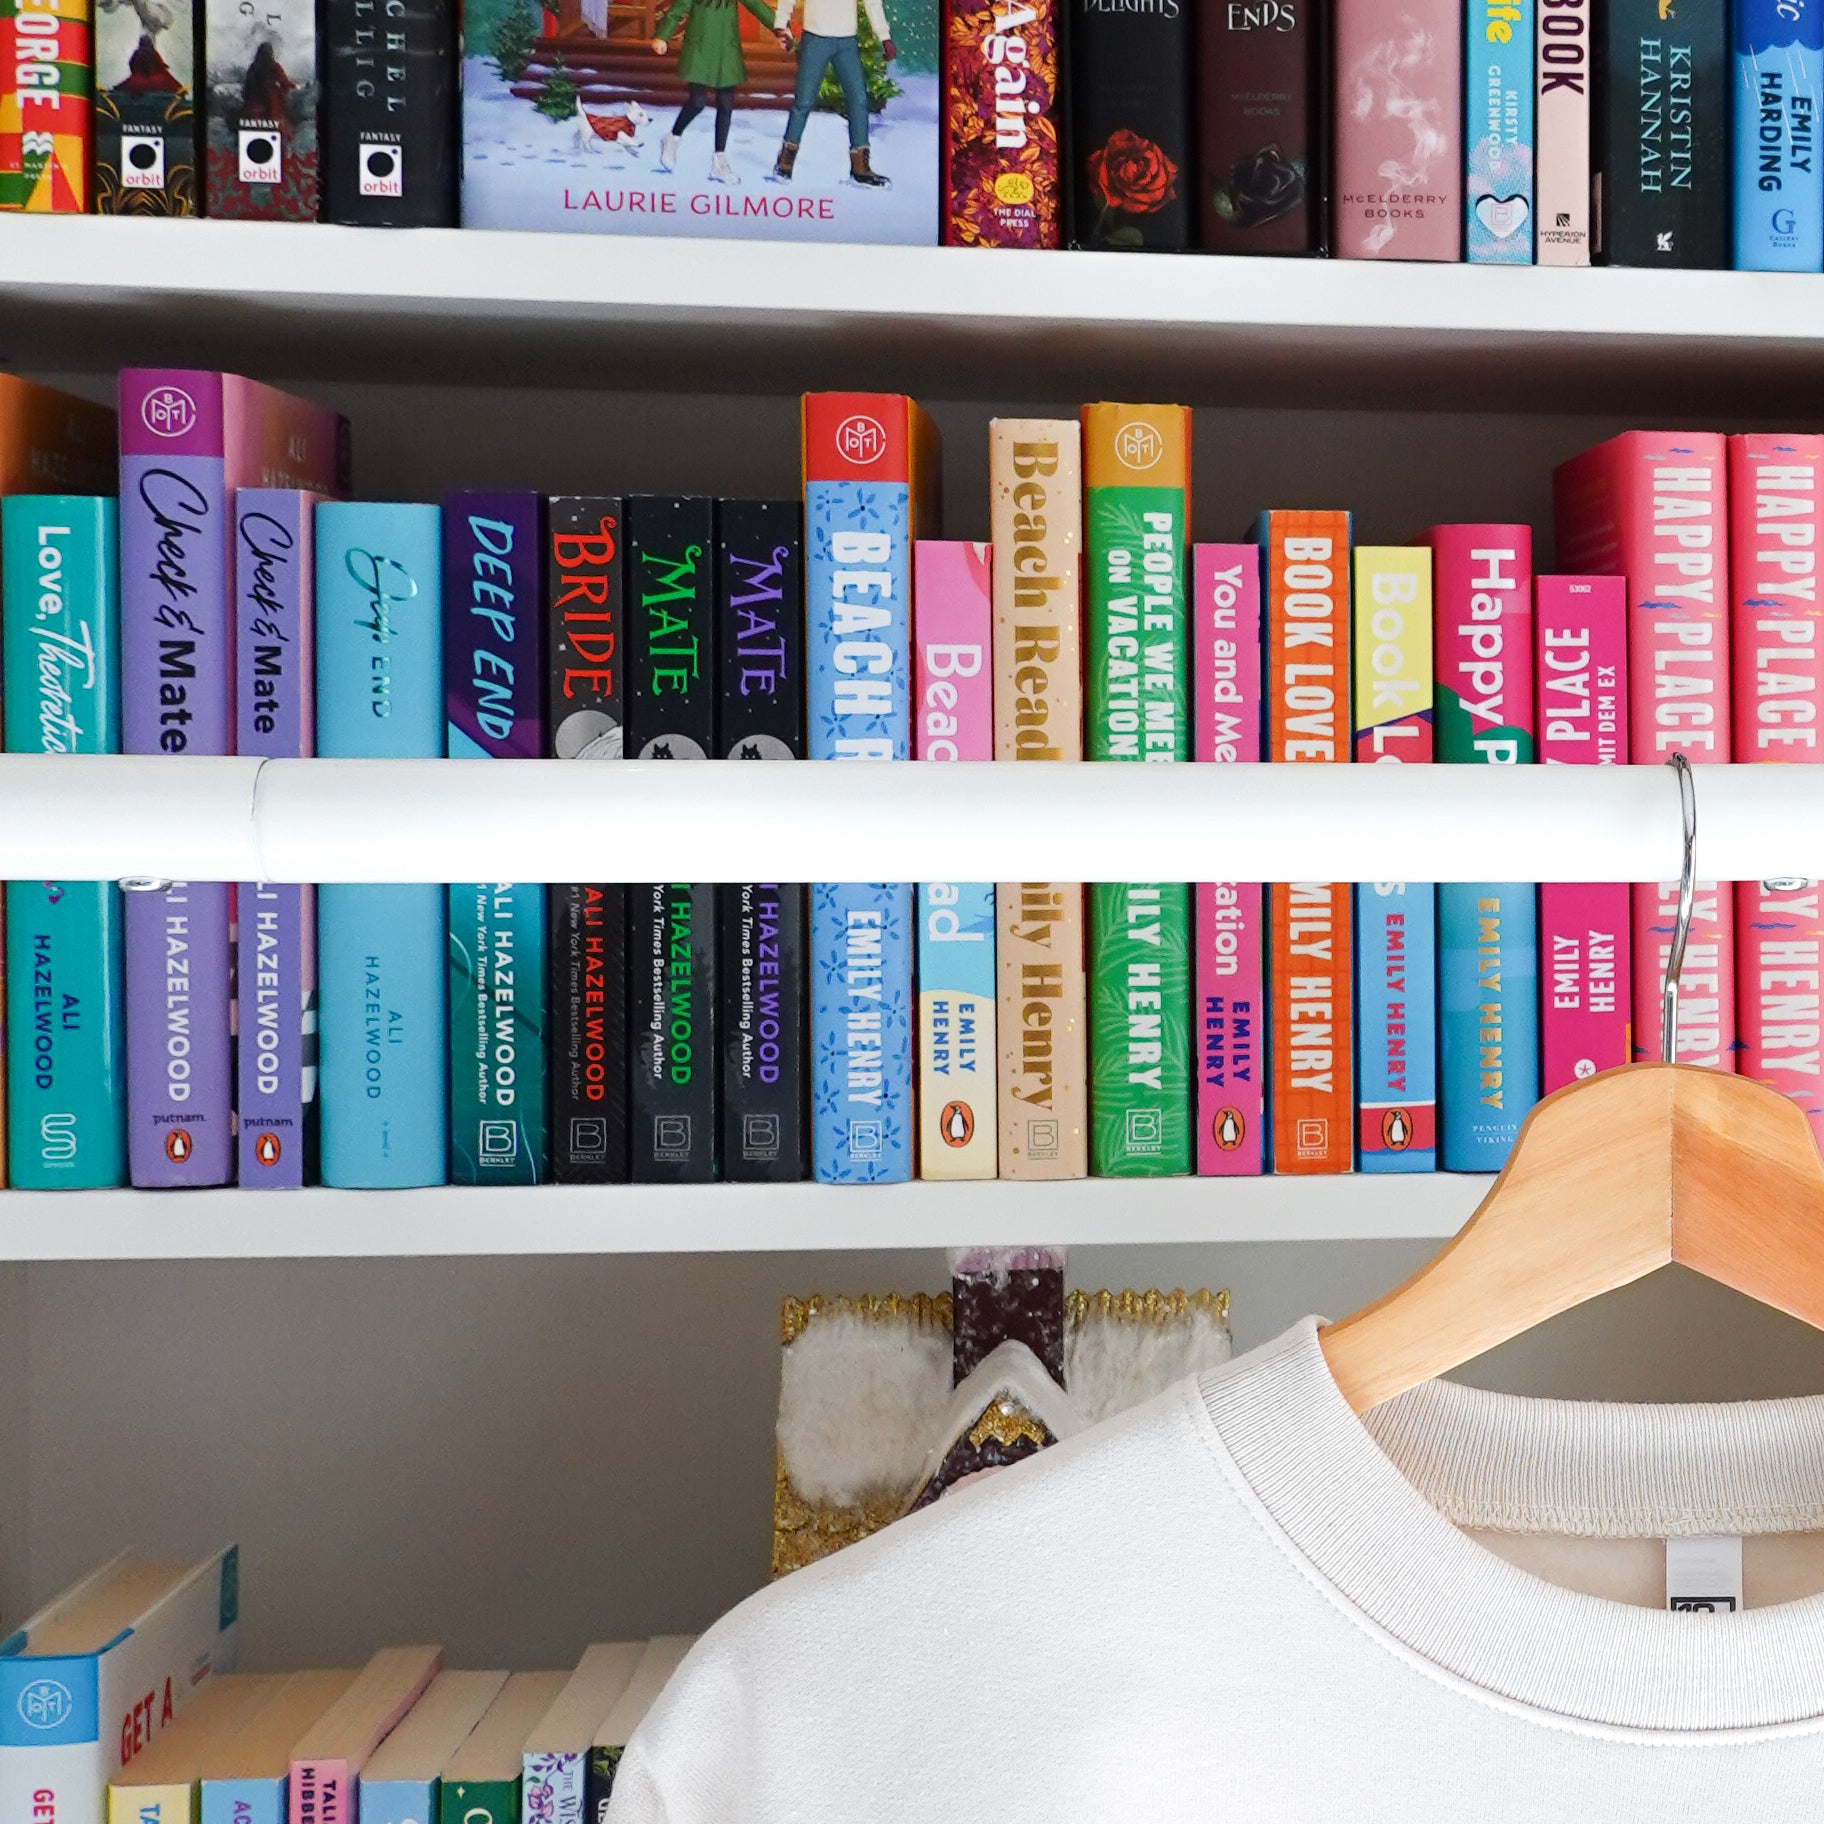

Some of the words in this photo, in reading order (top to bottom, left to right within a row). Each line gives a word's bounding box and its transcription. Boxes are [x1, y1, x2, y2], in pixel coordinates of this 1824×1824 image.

[125, 171, 163, 186] orbit
[1758, 72, 1782, 194] HARDING
[1791, 95, 1813, 174] EMILY
[564, 188, 677, 215] LAURIE
[691, 192, 834, 220] GILMORE
[36, 525, 71, 621] Love,
[466, 512, 520, 642] DEEP
[1008, 441, 1060, 609] Beach
[1108, 548, 1130, 582] ON
[1140, 511, 1174, 648] PEOPLE
[1755, 463, 1814, 606] HAPPY
[553, 515, 617, 698] BRIDE
[832, 532, 893, 716] BEACH
[1282, 537, 1333, 652] BOOK
[156, 638, 197, 752] Mate
[472, 637, 514, 741] END
[1013, 616, 1060, 760] Read
[1106, 593, 1138, 757] VACATION
[1144, 655, 1174, 713] WE
[1757, 617, 1816, 748] PLACE
[34, 934, 53, 1090] HAZELWOOD
[61, 993, 80, 1031] ALI
[847, 909, 877, 1002] EMILY
[847, 1007, 883, 1106] HENRY
